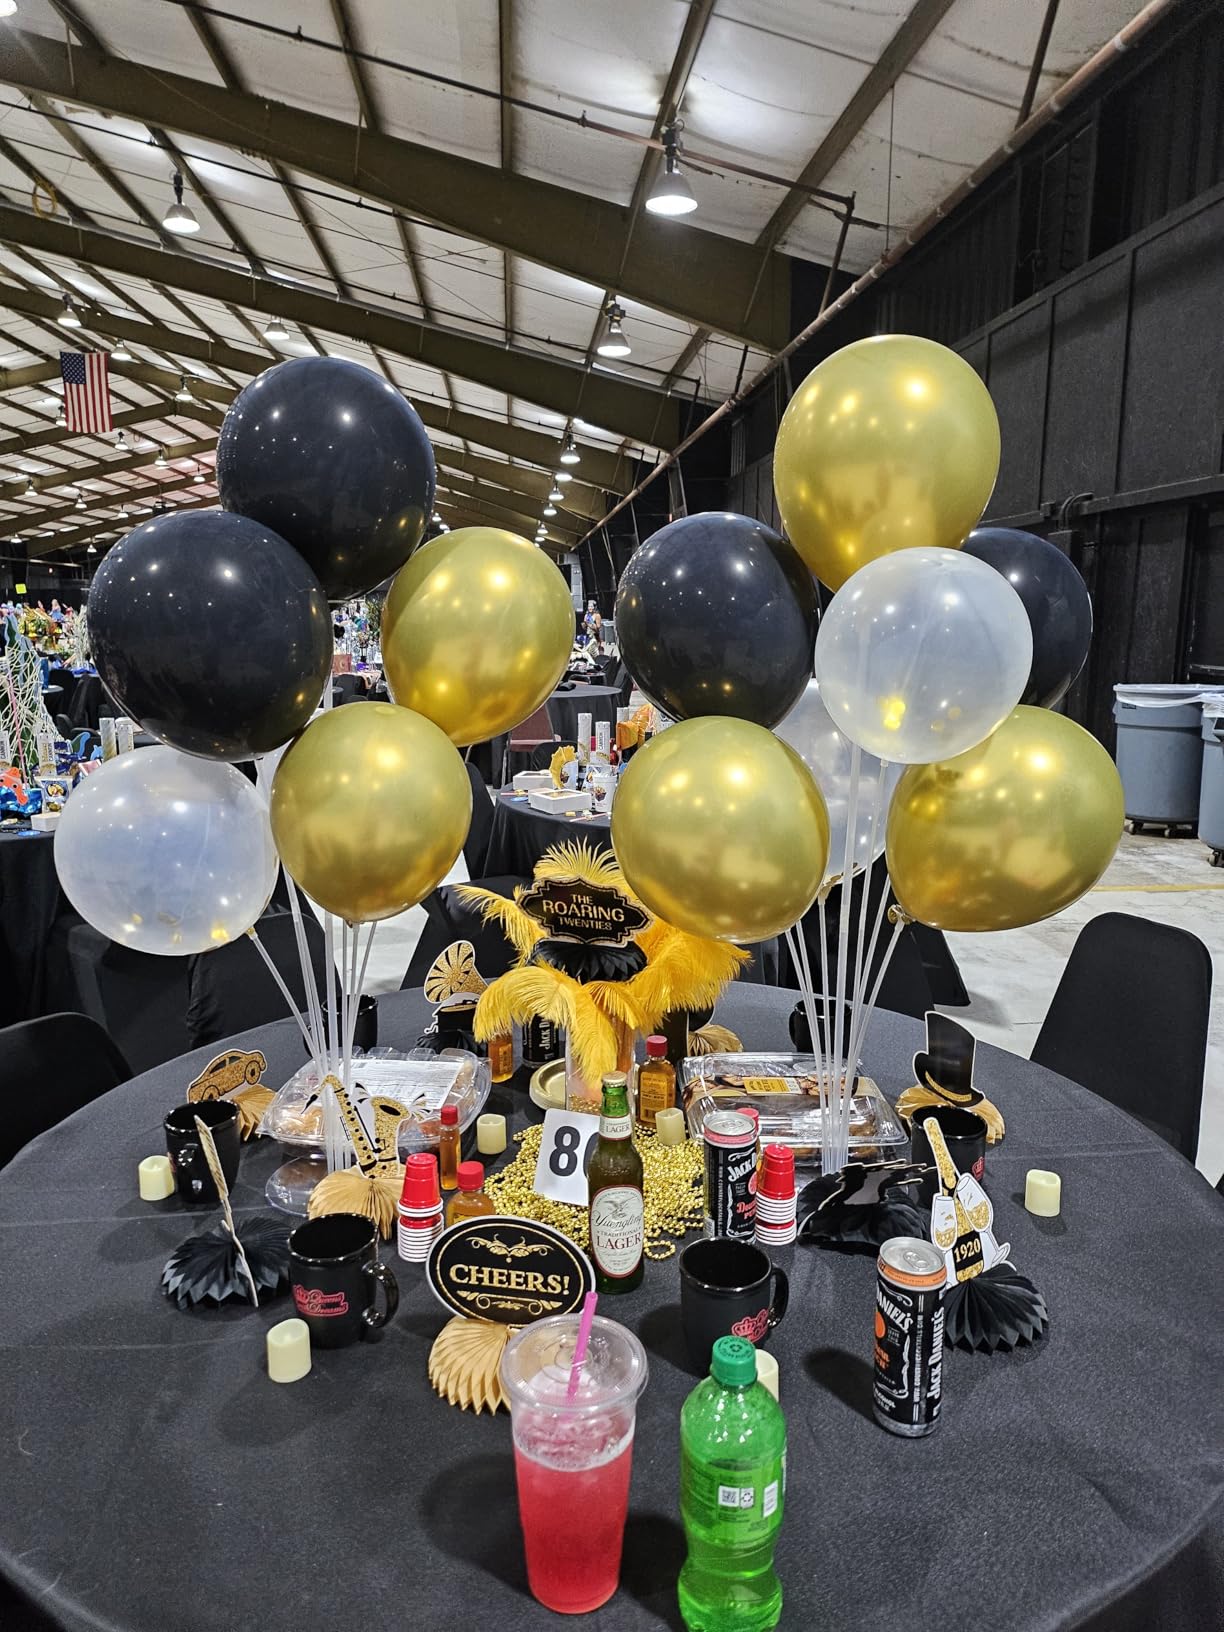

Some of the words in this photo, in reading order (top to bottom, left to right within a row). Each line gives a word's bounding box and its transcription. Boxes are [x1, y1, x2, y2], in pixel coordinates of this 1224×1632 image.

[542, 899, 625, 922] ROARING
[571, 893, 595, 905] THE
[558, 916, 613, 931] TWENTIES
[539, 1028, 551, 1050] JACK
[606, 1124, 630, 1133] LAGER
[727, 1158, 753, 1182] JACK
[596, 1232, 642, 1250] LAGER
[953, 1237, 981, 1263] 1920
[449, 1263, 570, 1296] CHEERS!
[876, 1281, 914, 1334] ANIEL'S
[926, 1362, 943, 1400] JACK
